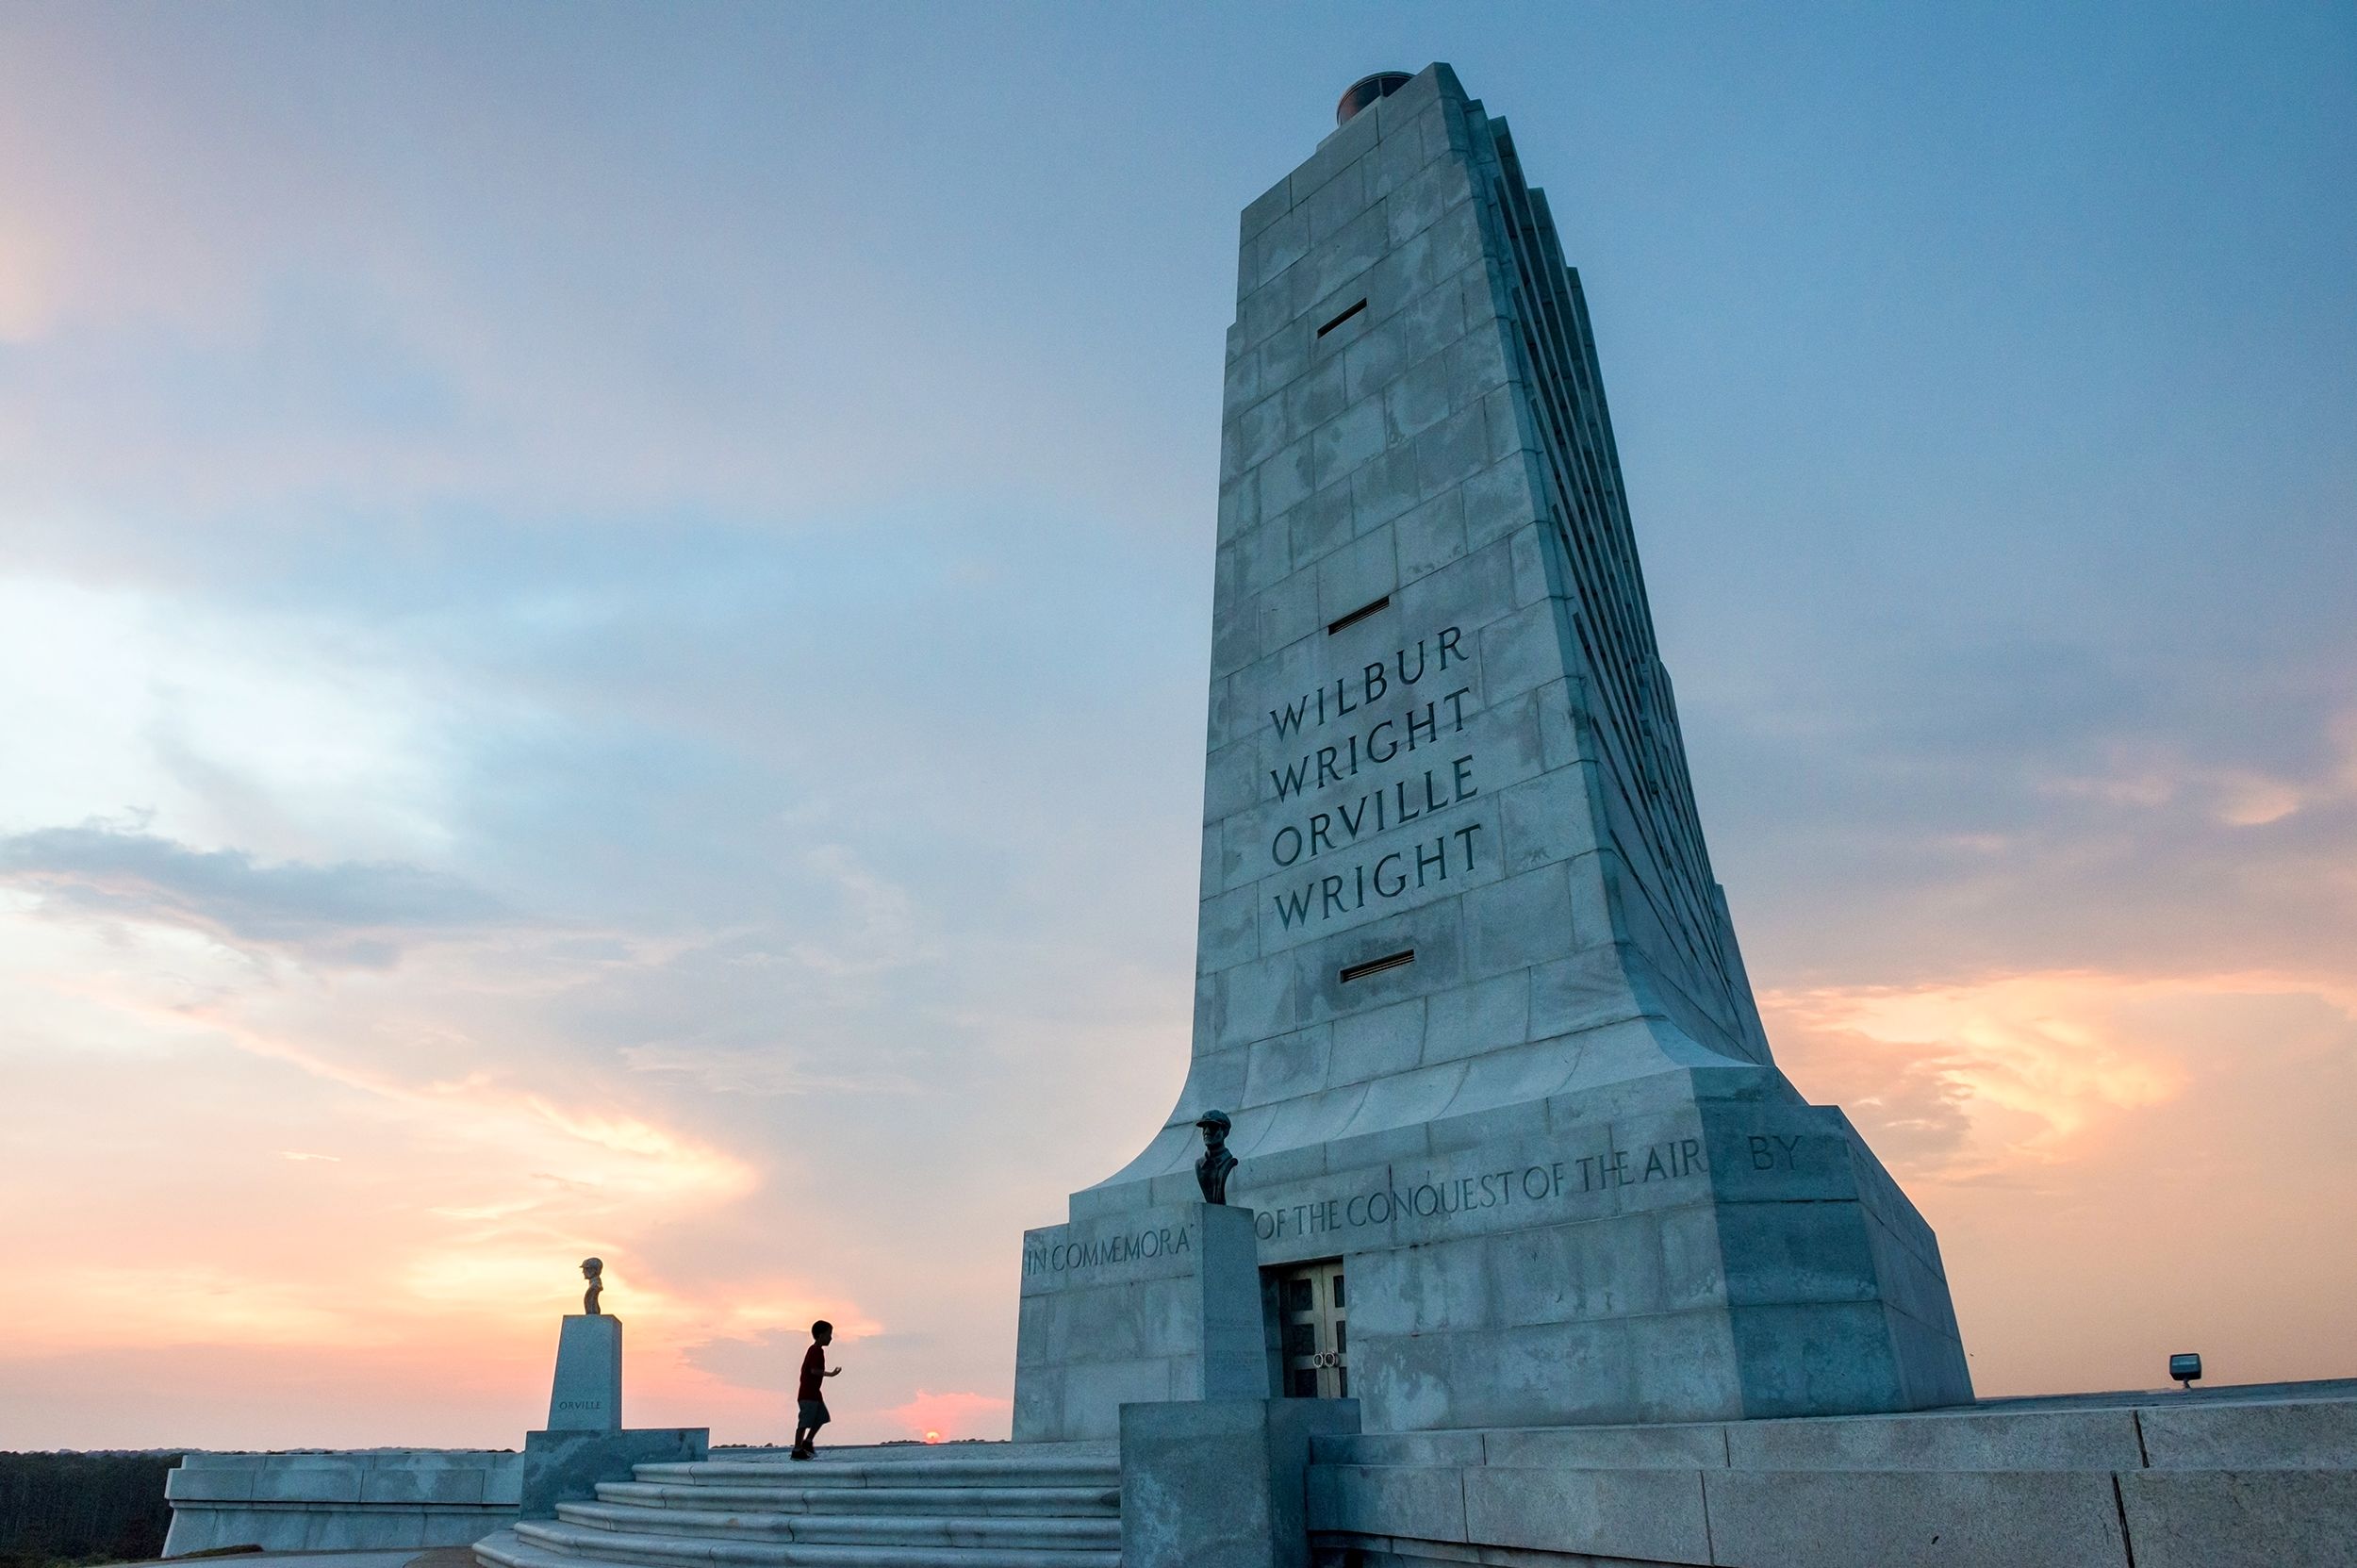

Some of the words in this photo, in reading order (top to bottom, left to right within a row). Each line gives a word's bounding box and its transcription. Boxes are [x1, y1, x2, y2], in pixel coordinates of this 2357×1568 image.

[1269, 626, 1470, 742] WILBUR
[1269, 686, 1471, 803] WRIGHT
[1272, 754, 1478, 867] ORVILLE
[1274, 823, 1482, 932] WRIGHT
[1027, 1247, 1047, 1276] IN
[1051, 1223, 1195, 1271] COMMEMORA
[1255, 1208, 1286, 1240] OF
[1293, 1199, 1343, 1235] THE
[1346, 1170, 1513, 1226] CONQUEST
[1523, 1162, 1564, 1200] OF
[1575, 1150, 1636, 1193] THE
[1642, 1138, 1708, 1183] AIR
[1747, 1134, 1803, 1171] BY
[559, 1400, 601, 1411] ORVILLE
